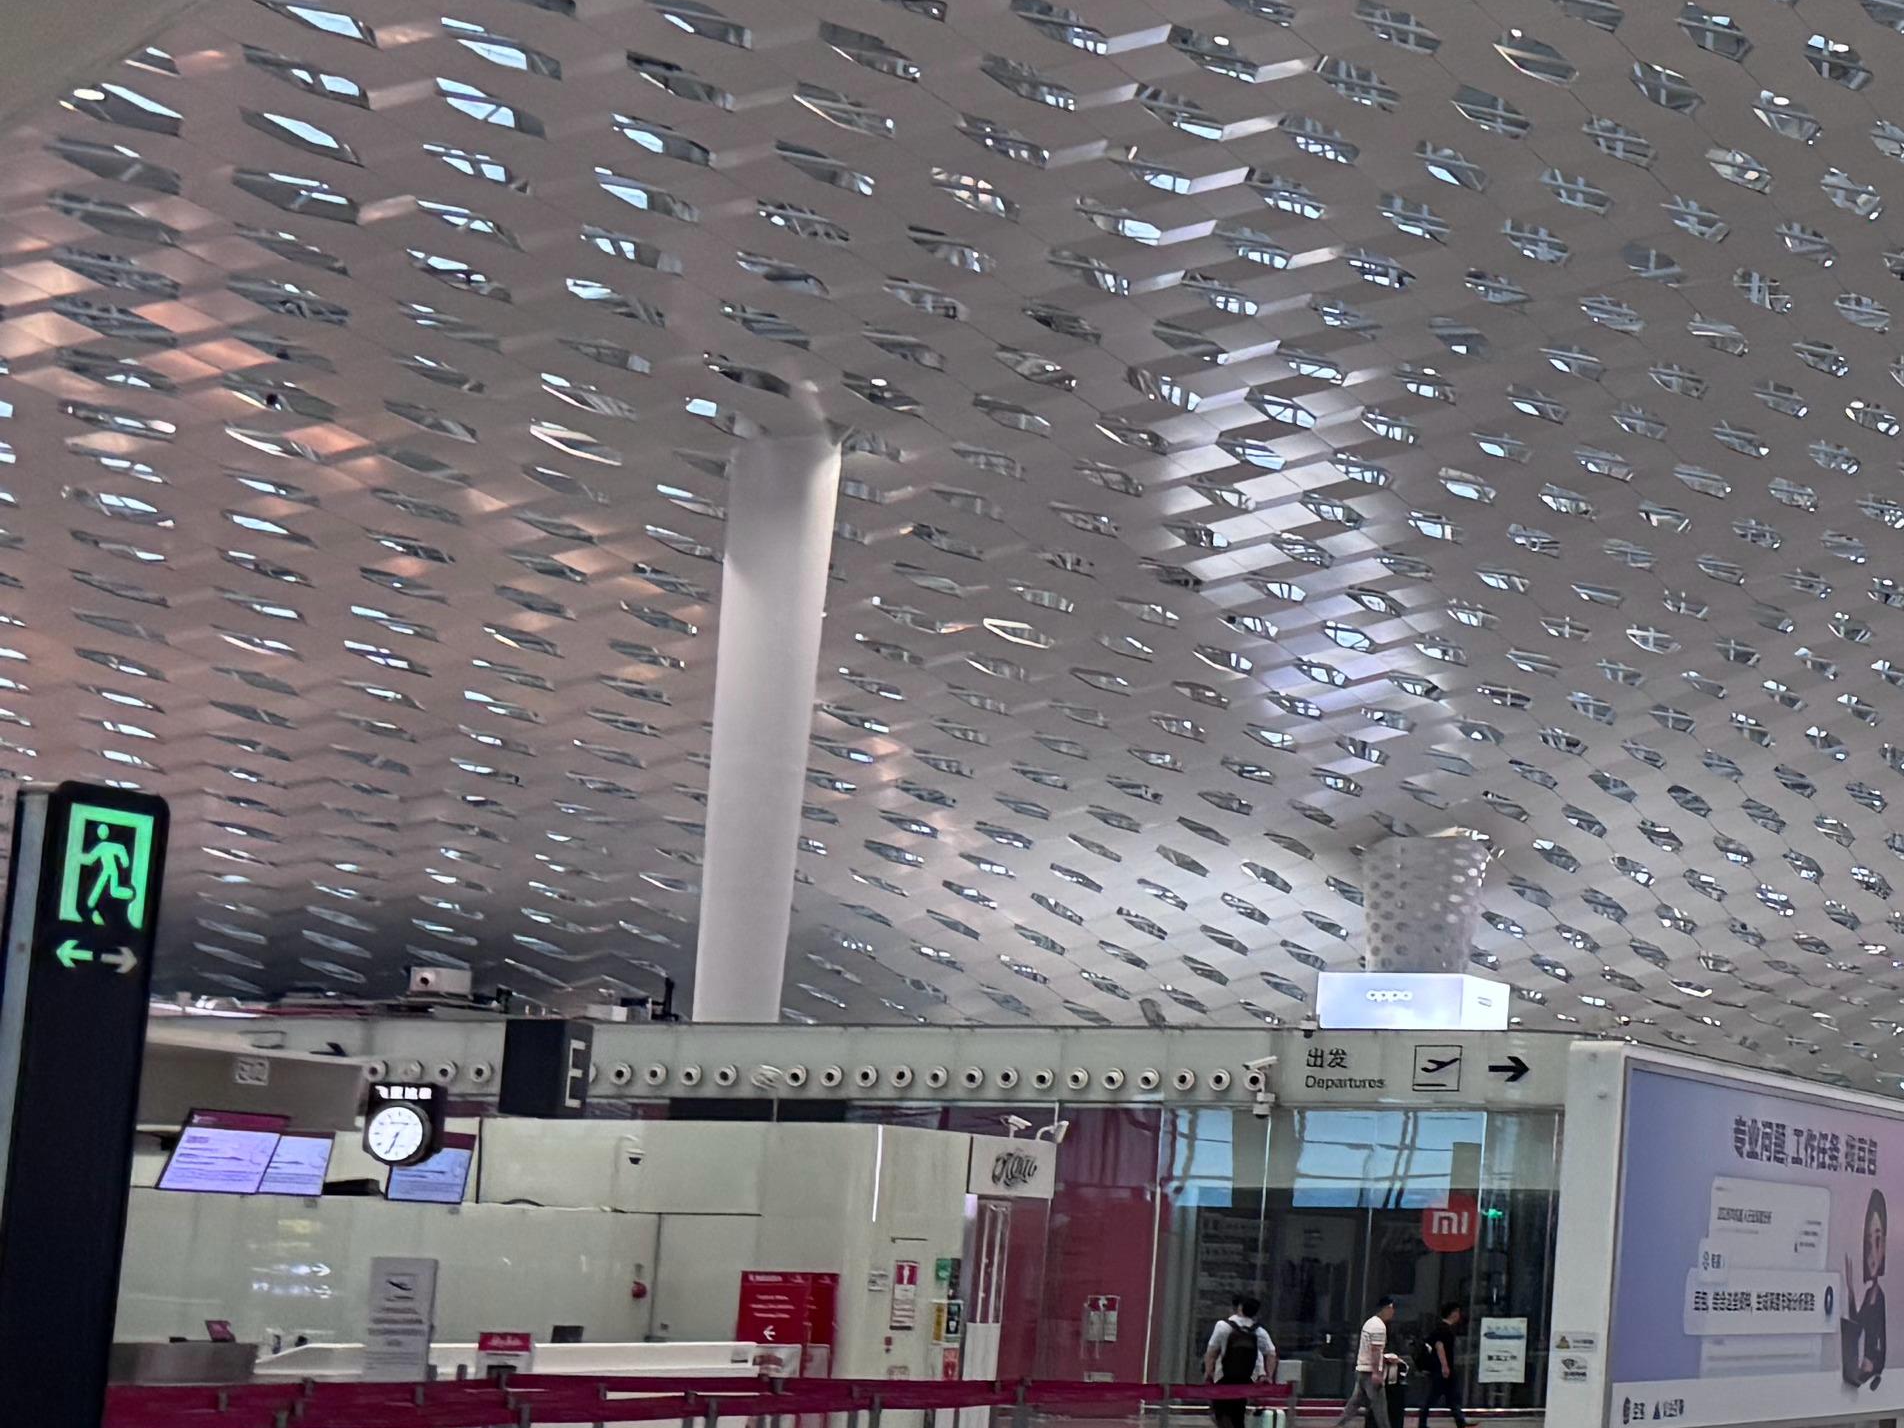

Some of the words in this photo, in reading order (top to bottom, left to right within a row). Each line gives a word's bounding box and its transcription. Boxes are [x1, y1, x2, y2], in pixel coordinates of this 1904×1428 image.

[1306, 1047, 1348, 1069] 出发
[564, 1039, 586, 1108] E
[1304, 1074, 1386, 1090] Departures
